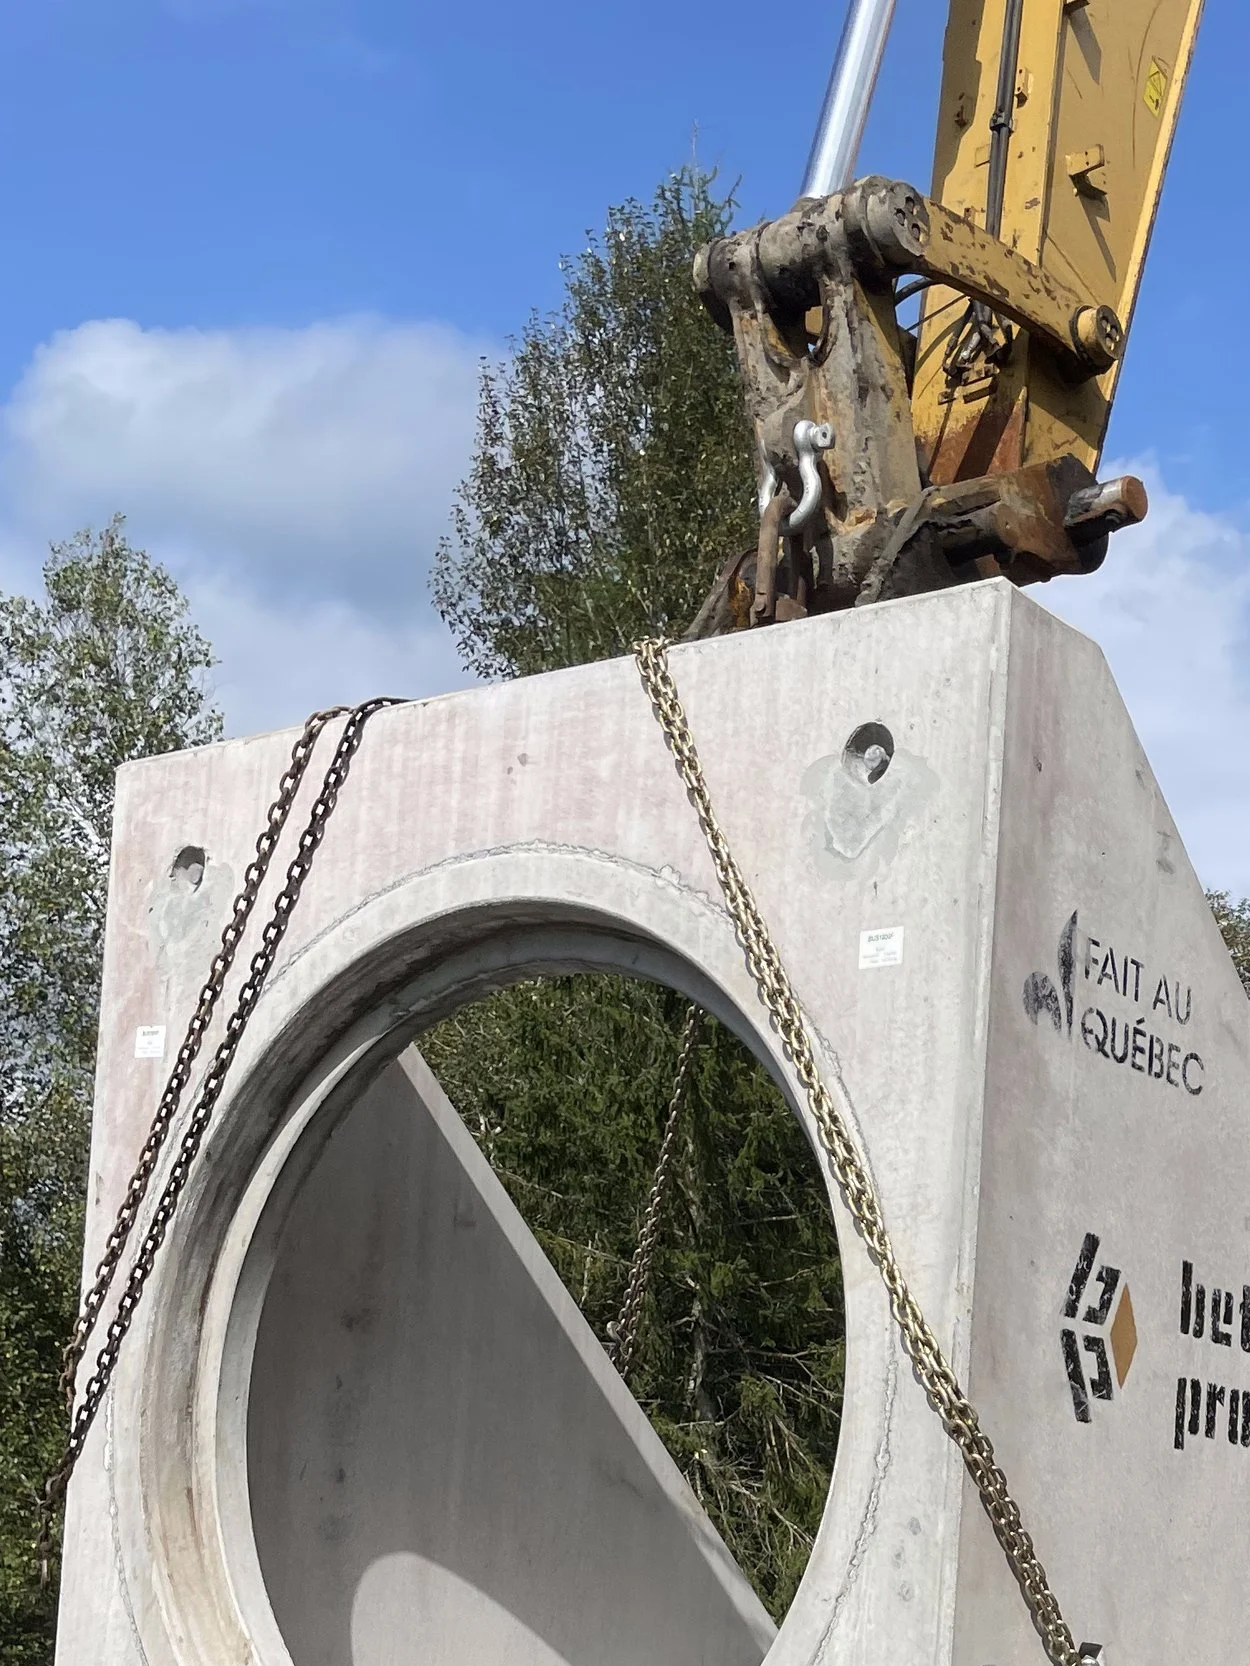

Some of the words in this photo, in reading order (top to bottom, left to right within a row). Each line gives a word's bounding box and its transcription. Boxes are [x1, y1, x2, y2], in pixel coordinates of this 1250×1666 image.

[1085, 936, 1144, 1003] FAIT
[1153, 974, 1191, 1025] AU
[1080, 1007, 1204, 1095] QUÉBEC
